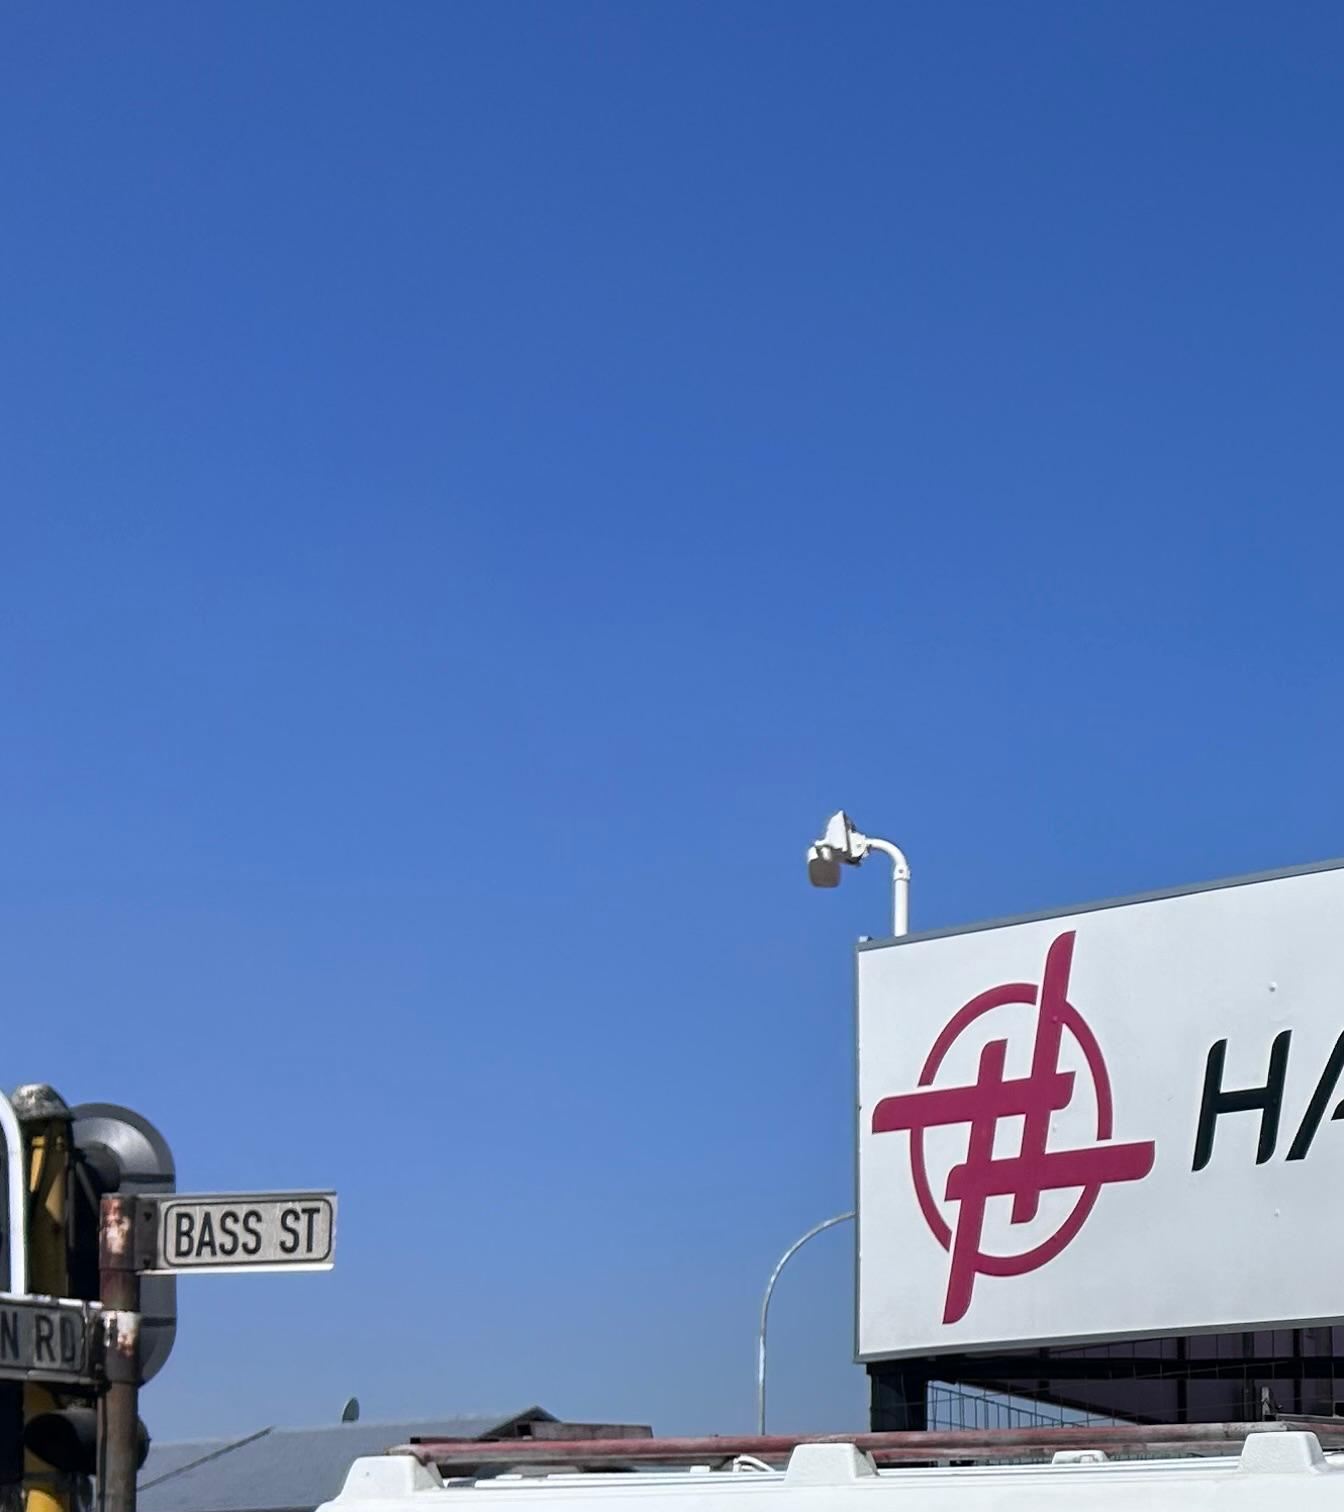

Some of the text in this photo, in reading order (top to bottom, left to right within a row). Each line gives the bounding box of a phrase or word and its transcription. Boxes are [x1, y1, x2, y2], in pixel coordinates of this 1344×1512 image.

[175, 1208, 320, 1257] BASS ST
[35, 1312, 76, 1362] RD
